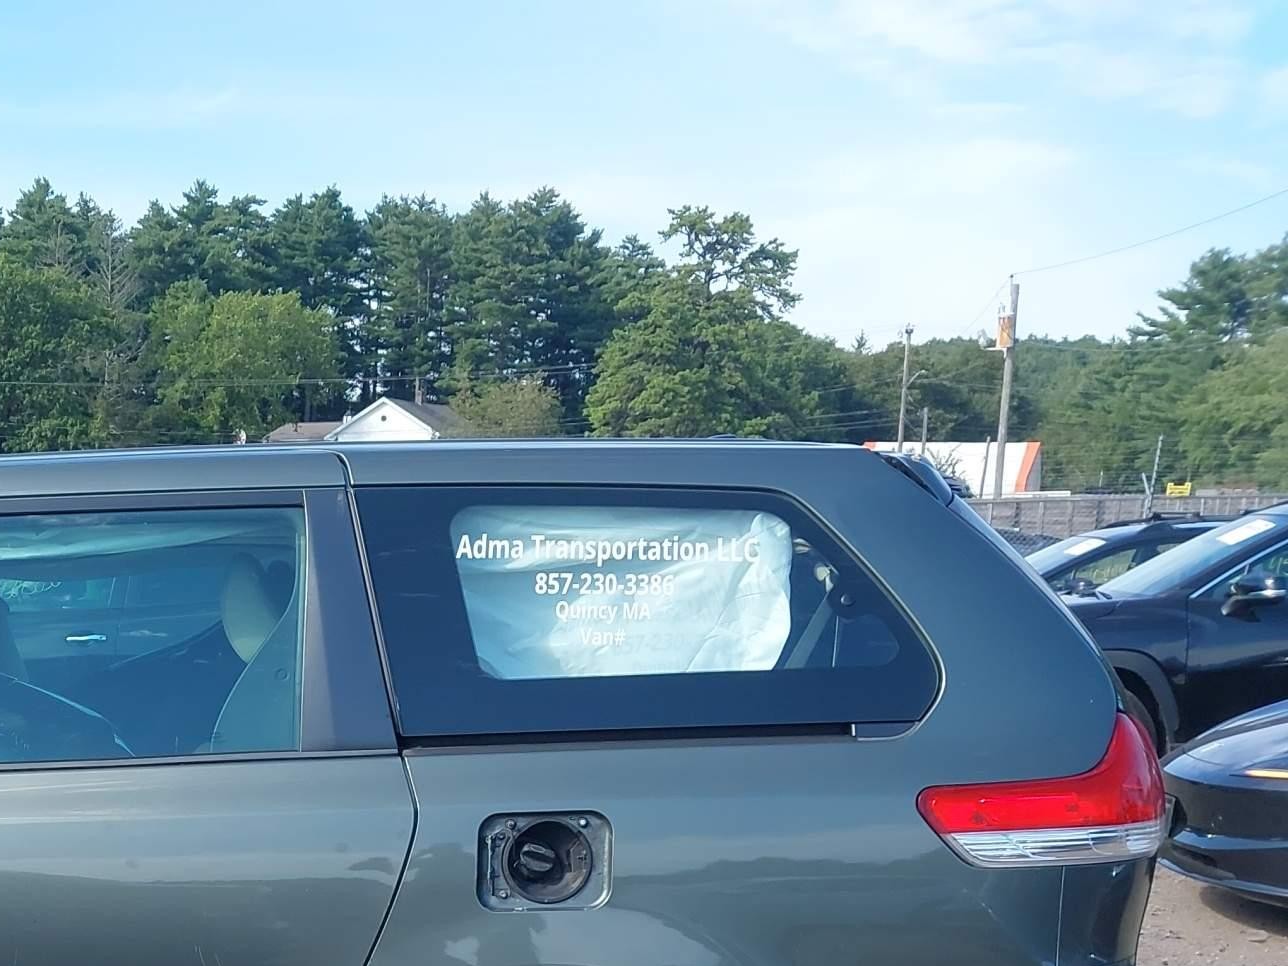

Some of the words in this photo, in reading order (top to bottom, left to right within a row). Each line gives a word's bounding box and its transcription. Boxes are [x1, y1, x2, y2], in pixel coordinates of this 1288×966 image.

[456, 534, 524, 559] Adma
[531, 535, 709, 567] Transportation
[717, 537, 761, 562] LLC
[534, 572, 675, 596] 857-230-3386
[555, 600, 619, 624] Quincy
[623, 604, 651, 620] MA
[580, 627, 627, 646] Van#
